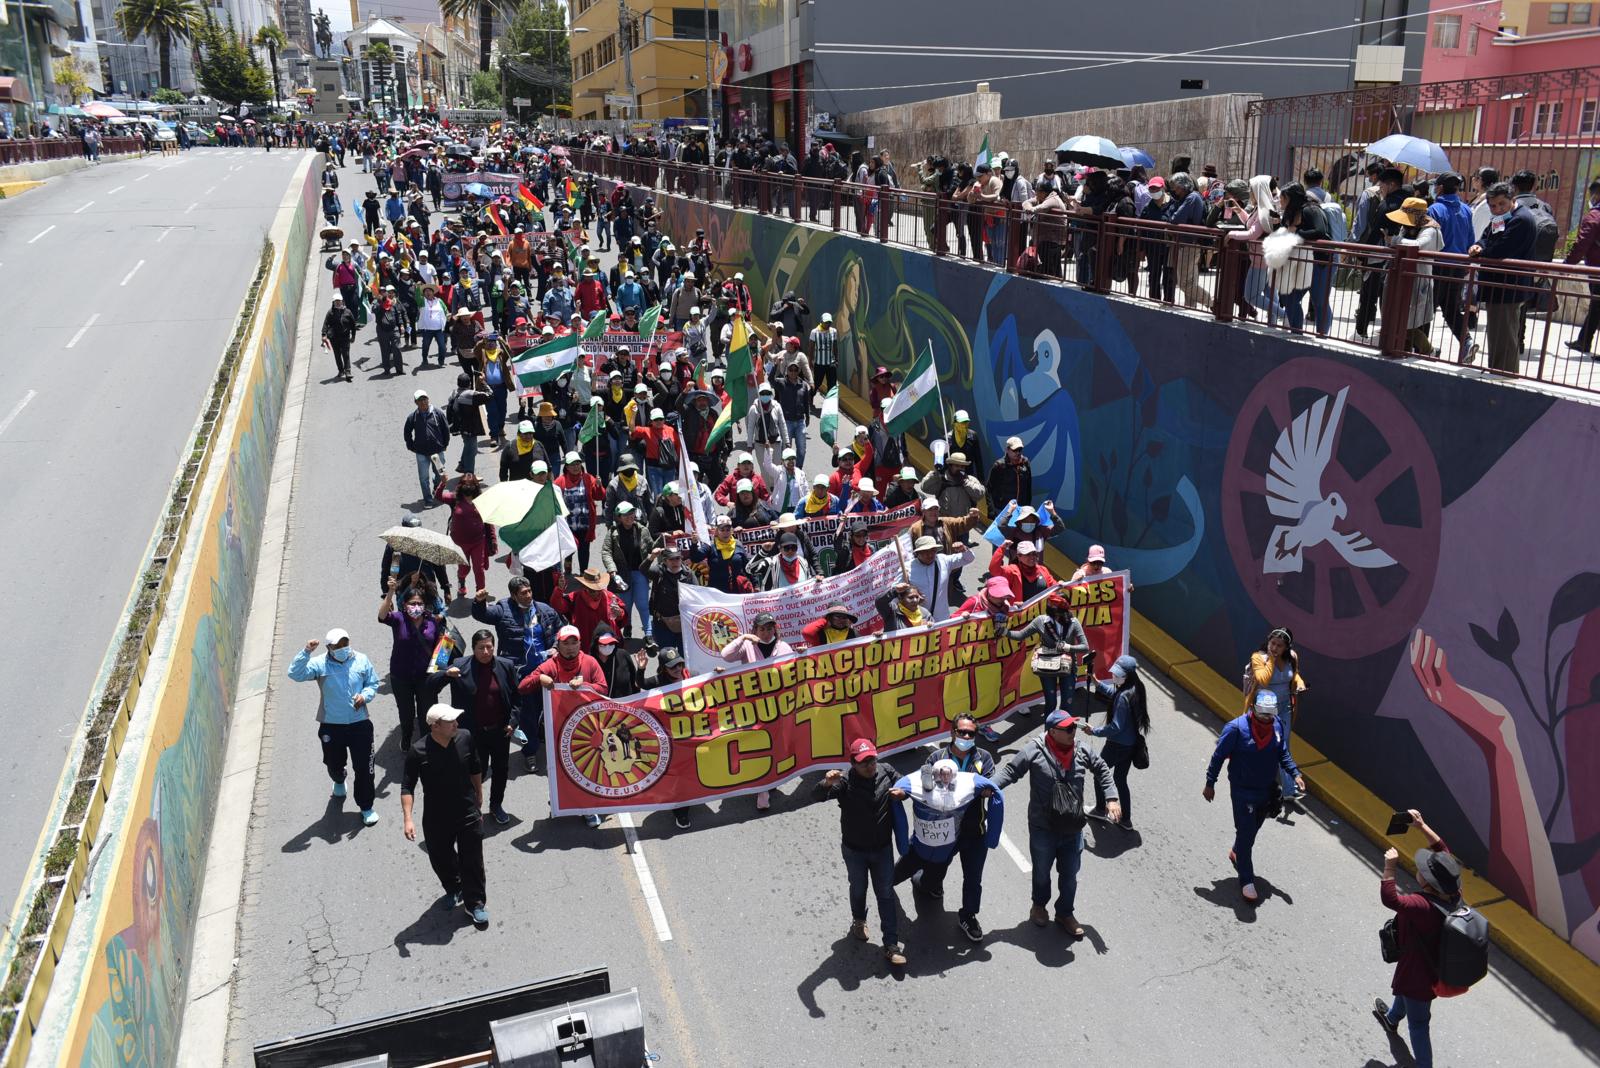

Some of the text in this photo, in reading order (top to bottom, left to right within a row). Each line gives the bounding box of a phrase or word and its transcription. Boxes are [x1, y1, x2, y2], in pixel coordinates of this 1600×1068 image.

[604, 344, 632, 353] URBA
[741, 519, 827, 543] DEPARNTAL
[826, 583, 840, 591] UNA
[745, 604, 784, 616] CONSENSO
[785, 602, 800, 611] QUE
[775, 611, 806, 622] AGUDIZA
[841, 595, 851, 603] NO
[660, 580, 1117, 714] CONFEDERACIÓN DE TRAAJARES
[670, 713, 703, 740] DE
[705, 667, 880, 730] EDUCACIÓN
[887, 642, 990, 686] URBANA
[1022, 604, 1113, 649] BVIA
[594, 784, 644, 797] C.T.E.U.B.
[922, 828, 949, 841] Pary
